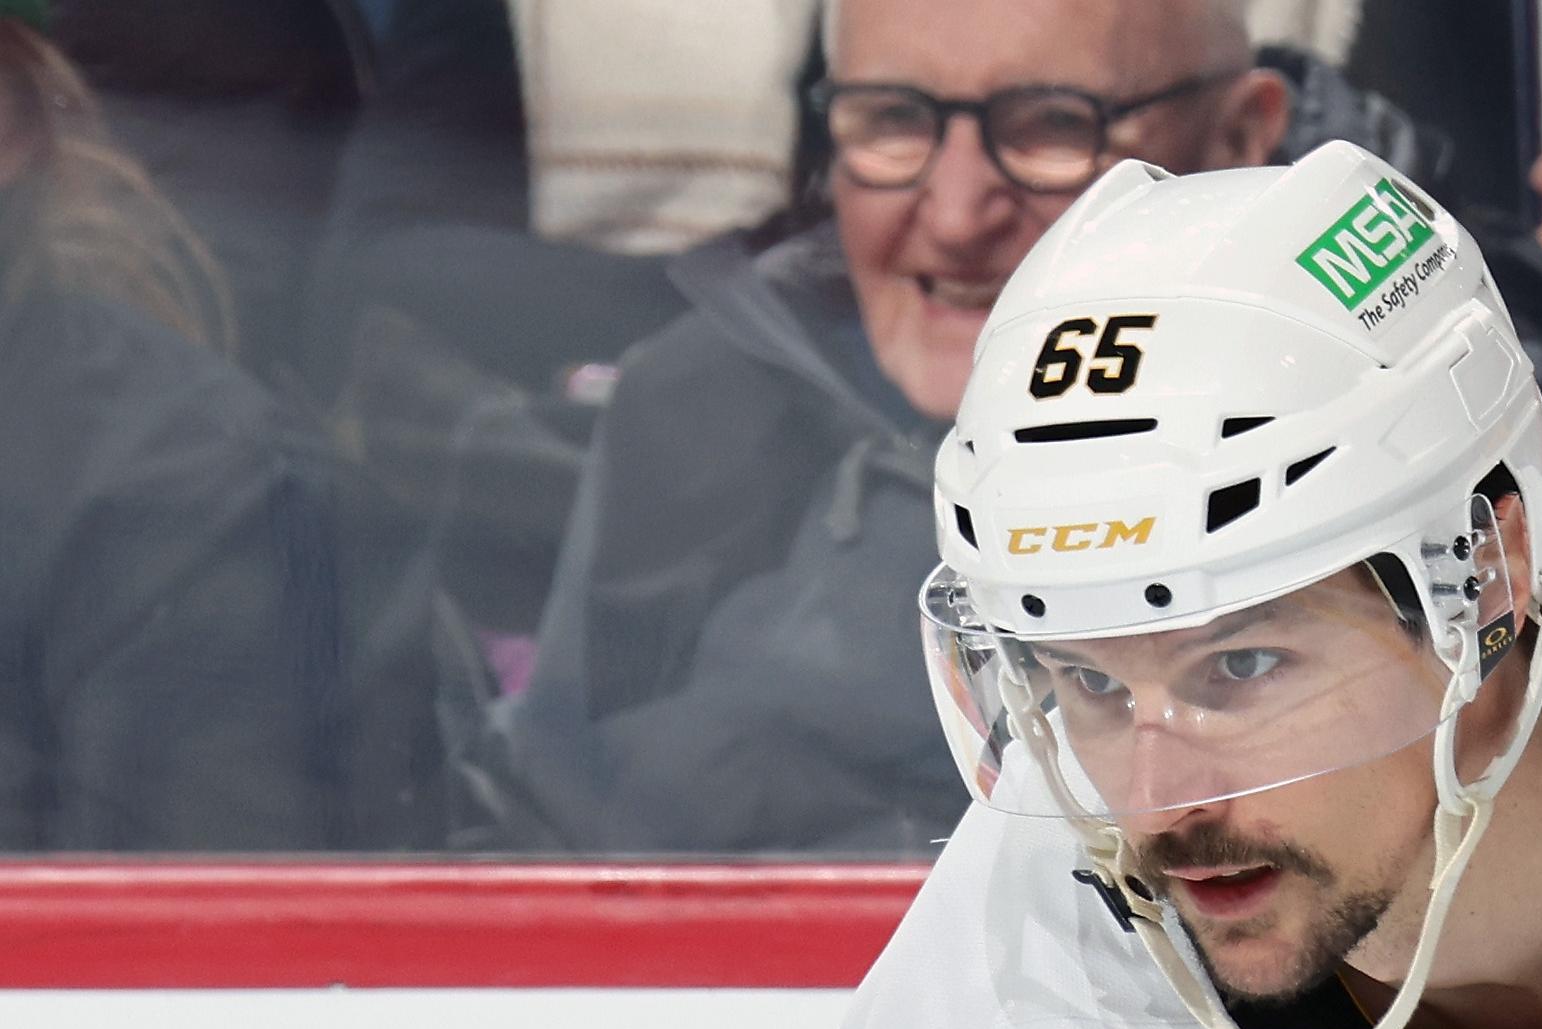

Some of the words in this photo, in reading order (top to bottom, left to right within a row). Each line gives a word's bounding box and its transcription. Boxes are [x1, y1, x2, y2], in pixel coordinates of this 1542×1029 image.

[1311, 190, 1428, 299] MSA
[1358, 308, 1386, 331] The
[1381, 273, 1420, 309] Safety
[1028, 313, 1160, 402] 65
[1006, 516, 1158, 556] CCM
